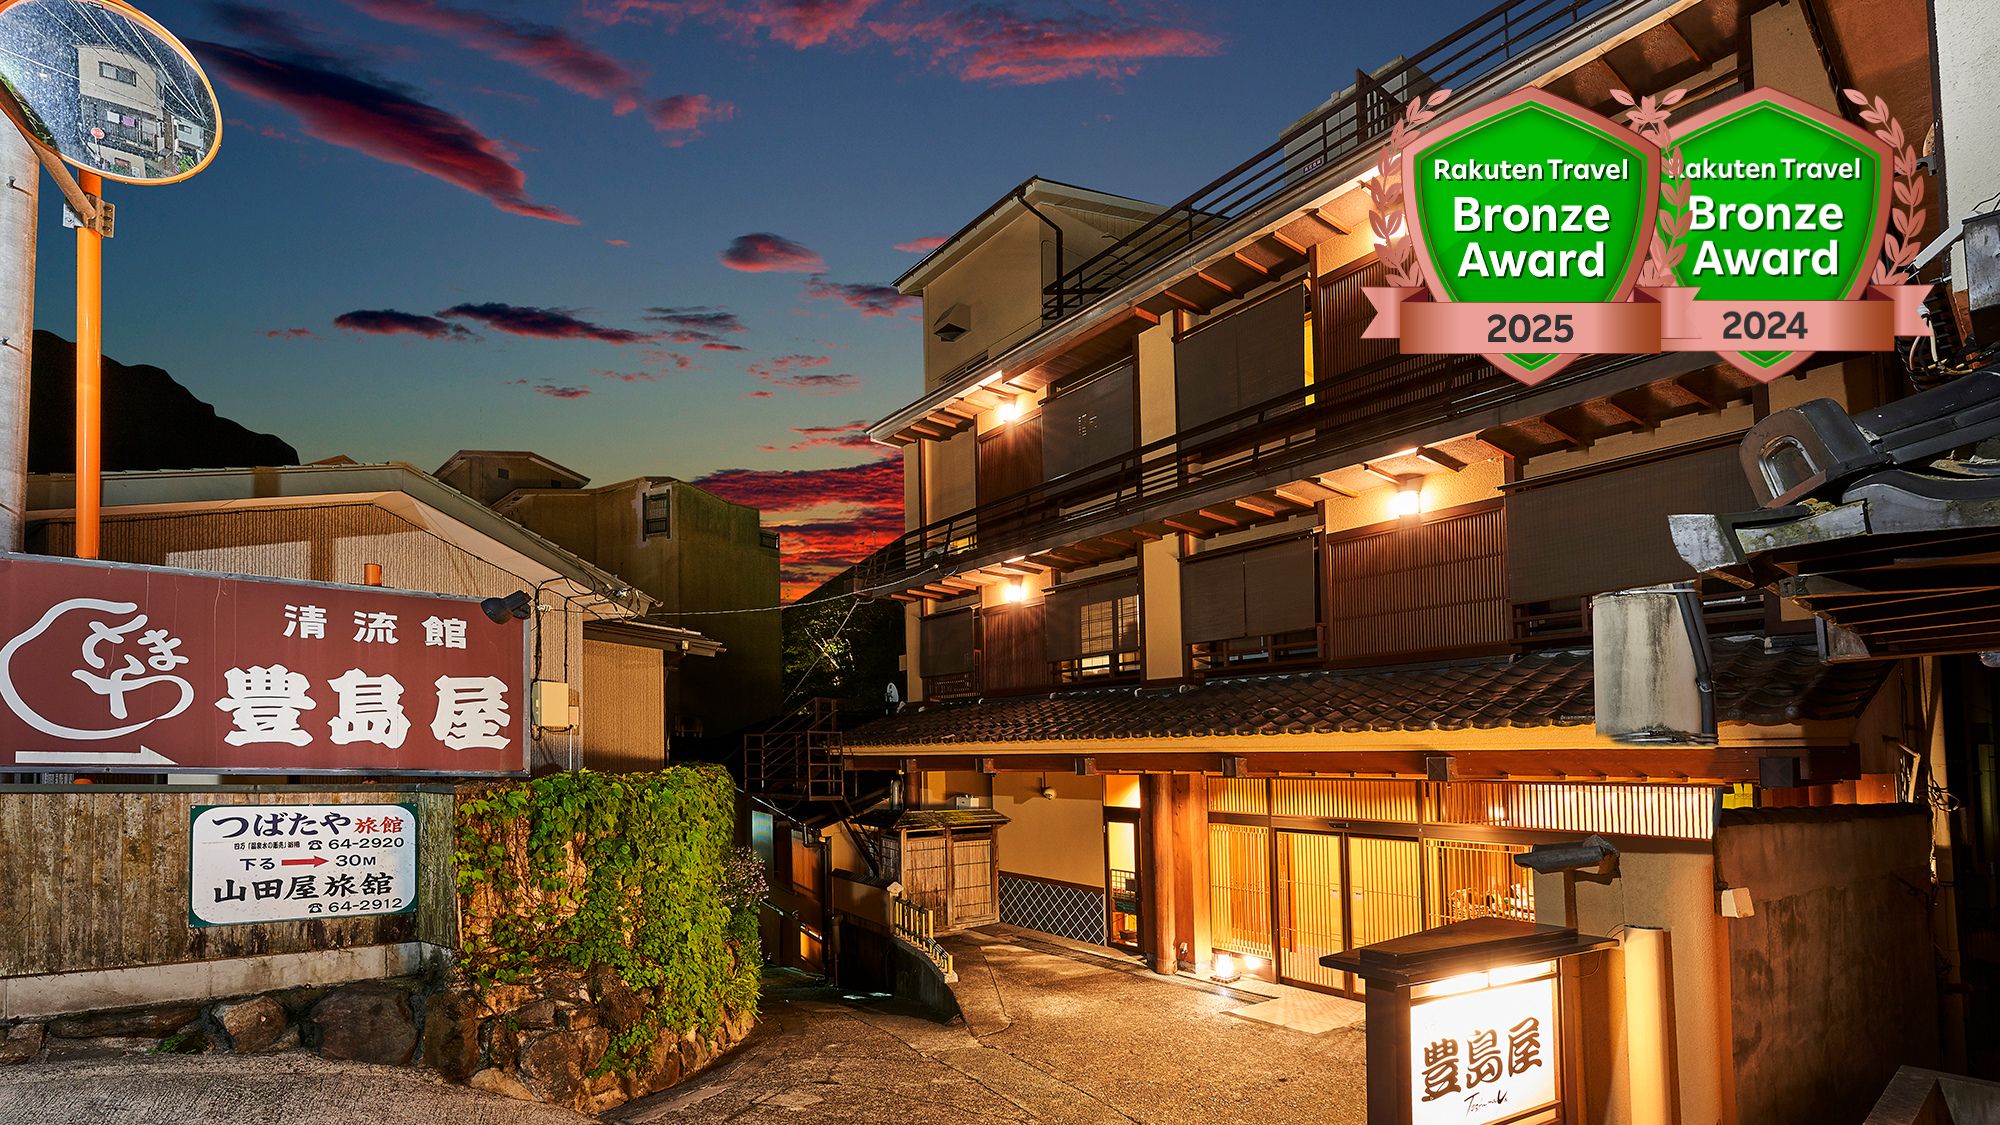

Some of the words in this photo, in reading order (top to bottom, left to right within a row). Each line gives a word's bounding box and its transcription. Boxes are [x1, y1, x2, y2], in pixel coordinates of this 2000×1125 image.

[283, 603, 468, 650] 清流館
[214, 663, 512, 750] 豊島屋
[327, 837, 405, 850] 64-2920
[239, 857, 276, 871] 下る
[327, 897, 403, 912] 64-2912
[1421, 1016, 1543, 1103] 豊島屋
